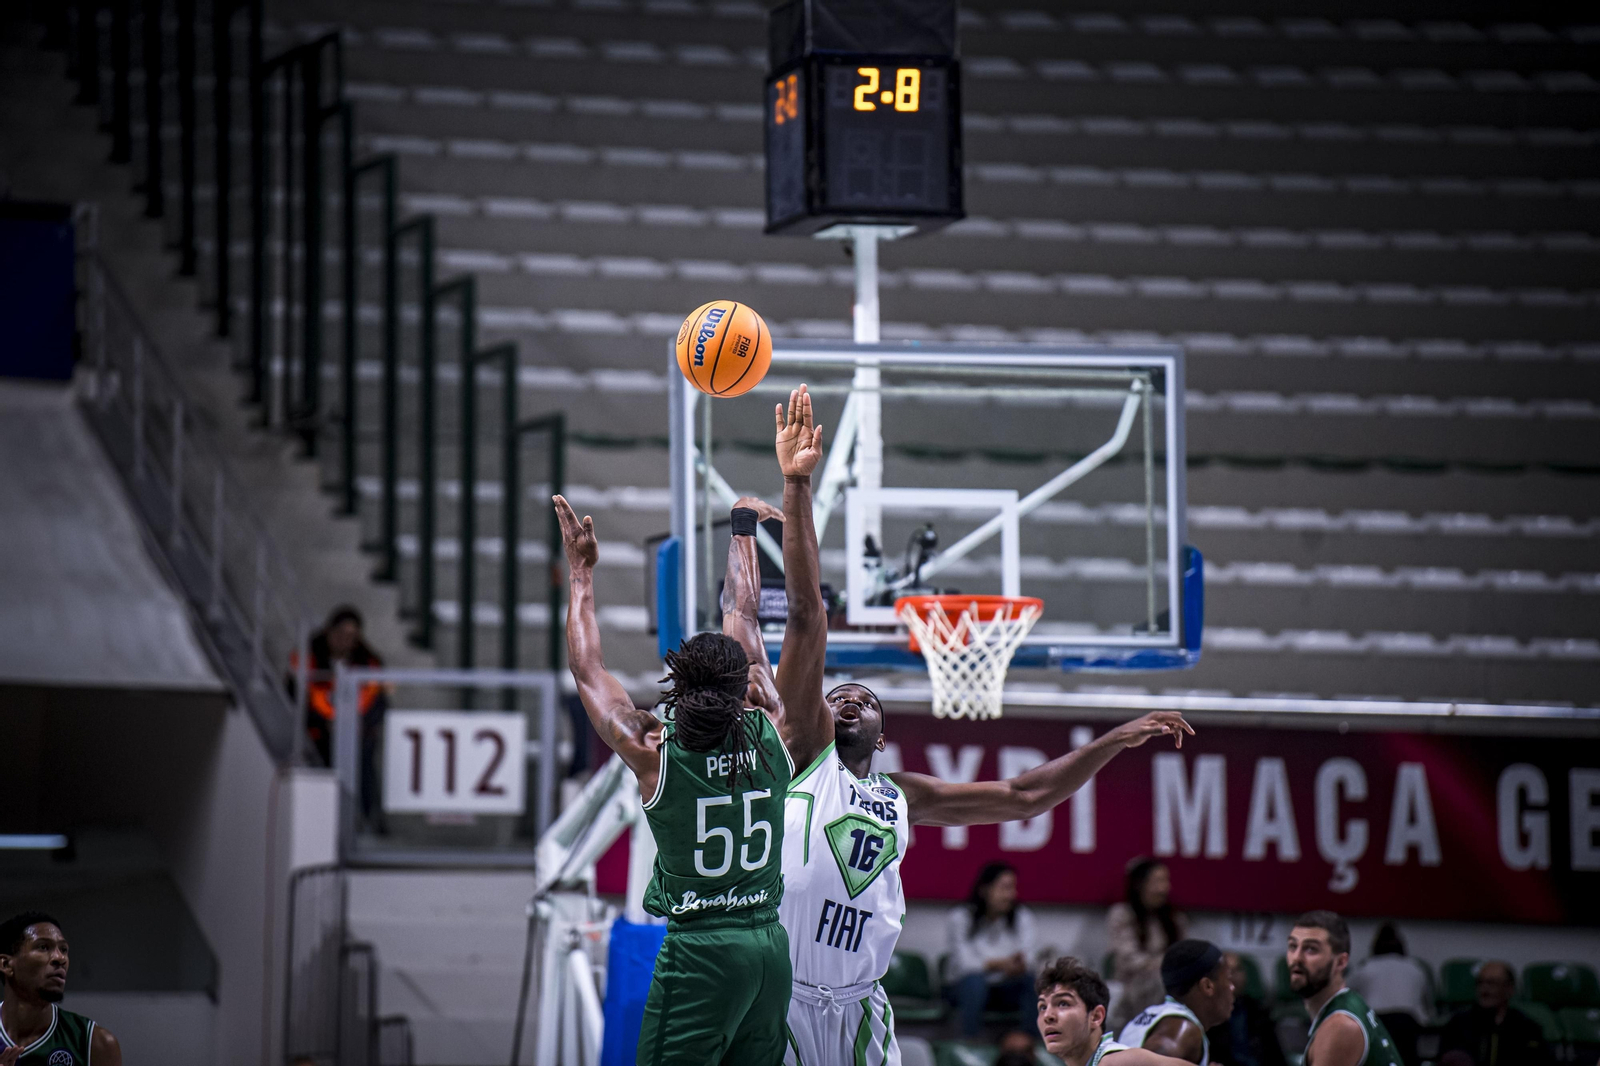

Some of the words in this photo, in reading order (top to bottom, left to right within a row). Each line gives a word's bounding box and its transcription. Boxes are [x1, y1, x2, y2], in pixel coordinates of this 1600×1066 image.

[694, 308, 727, 367] Wilson
[737, 336, 751, 358] FIBA
[404, 729, 506, 795] 112
[694, 788, 772, 877] 55
[847, 828, 884, 873] 16
[1151, 752, 1443, 893] MAÇA
[815, 899, 873, 953] FIAT
